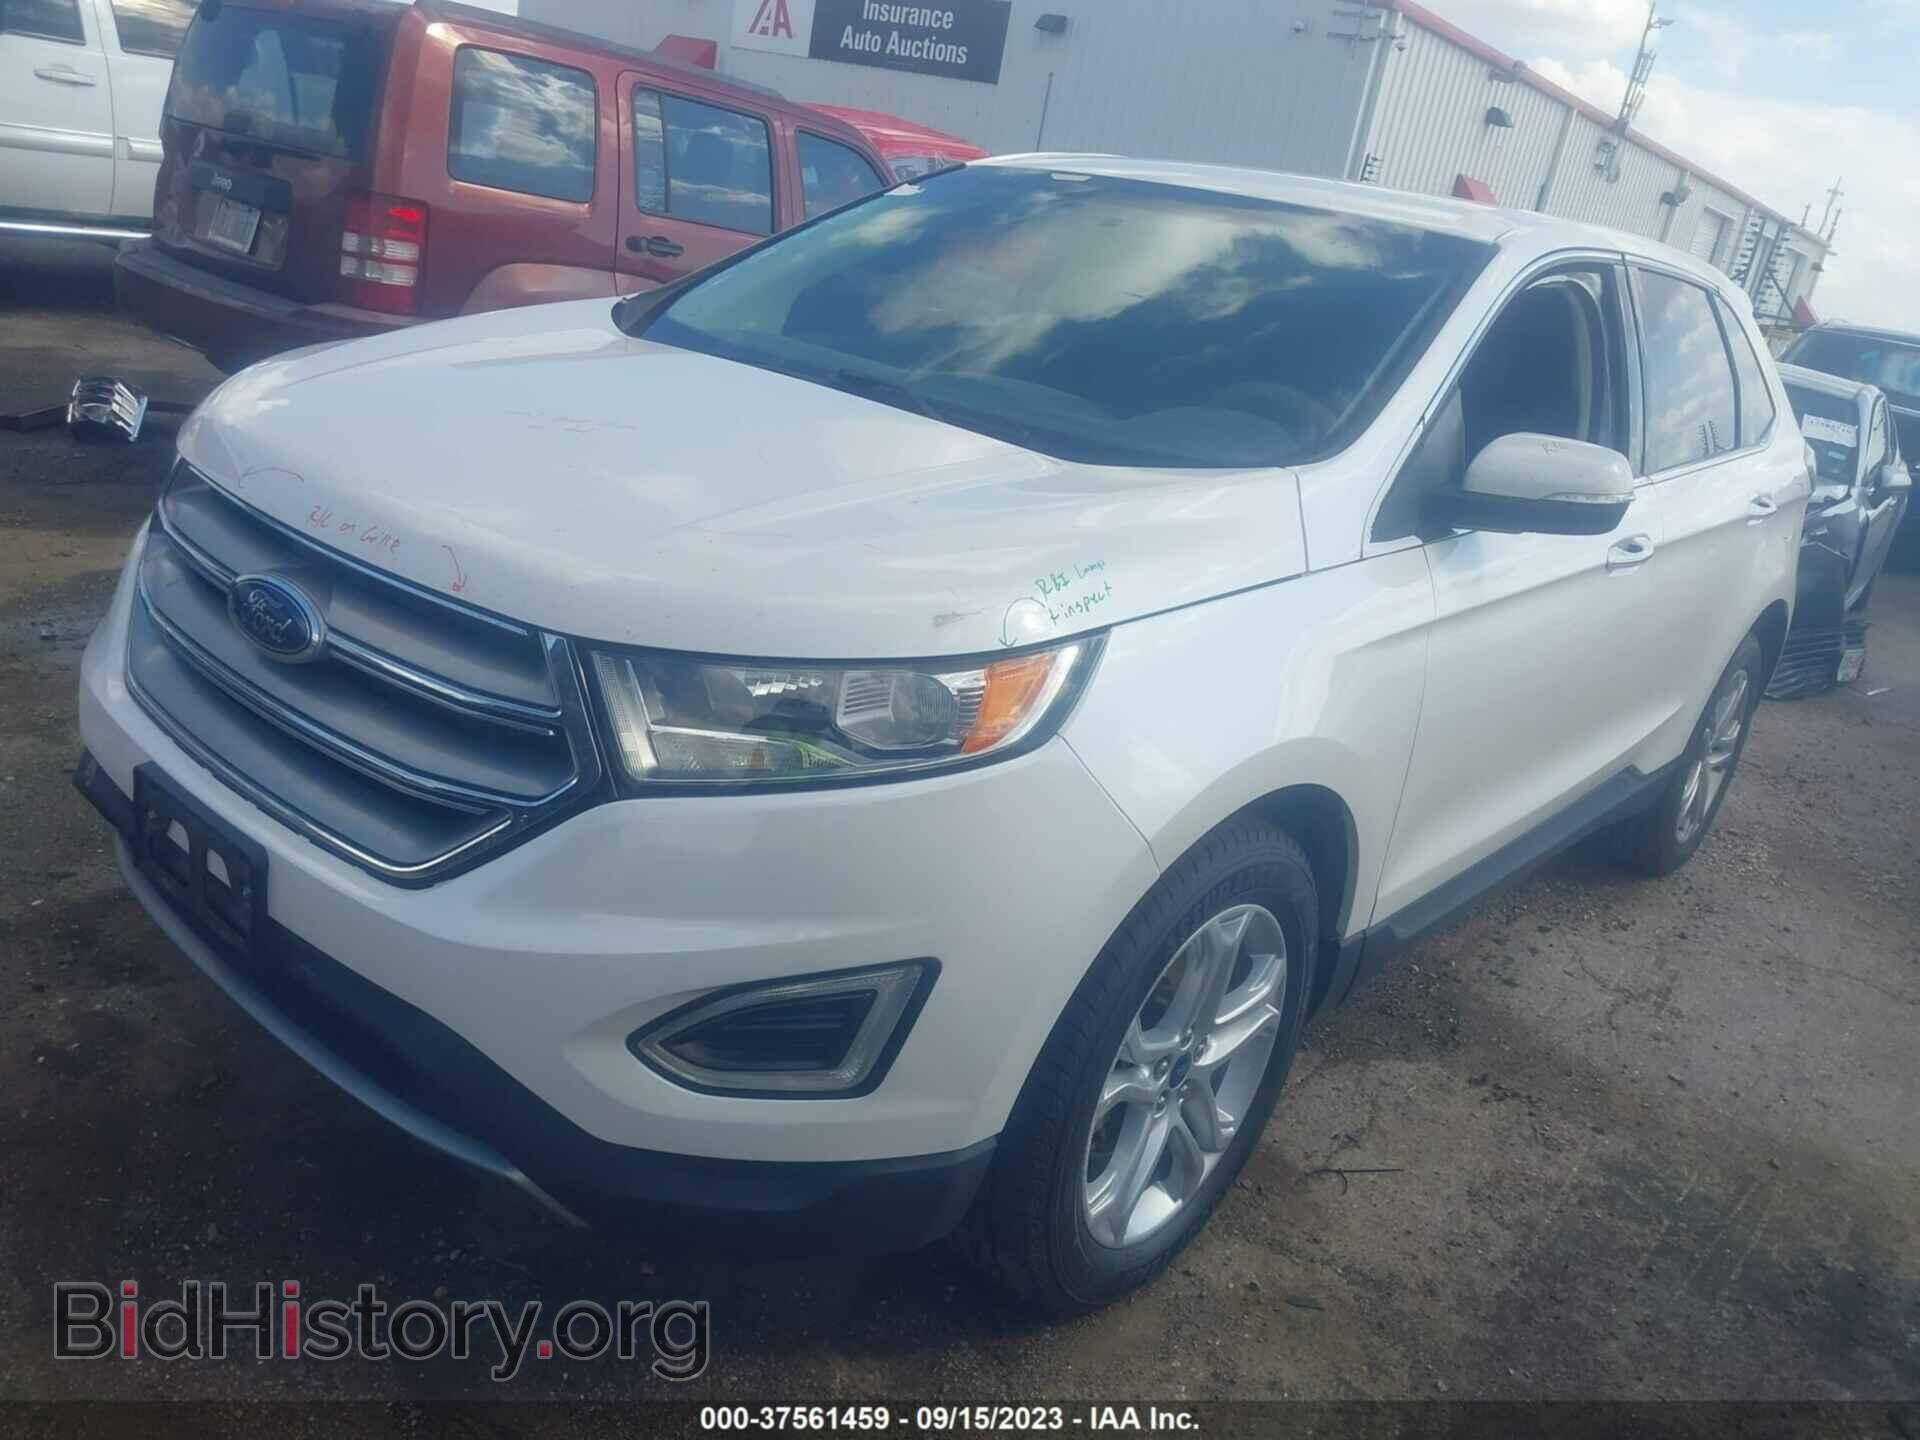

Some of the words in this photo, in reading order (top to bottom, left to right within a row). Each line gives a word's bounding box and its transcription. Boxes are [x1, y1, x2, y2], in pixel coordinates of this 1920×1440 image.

[862, 0, 954, 30] Insurance
[839, 25, 882, 53] Auto
[885, 31, 968, 64] Auctions
[241, 589, 293, 643] Ford
